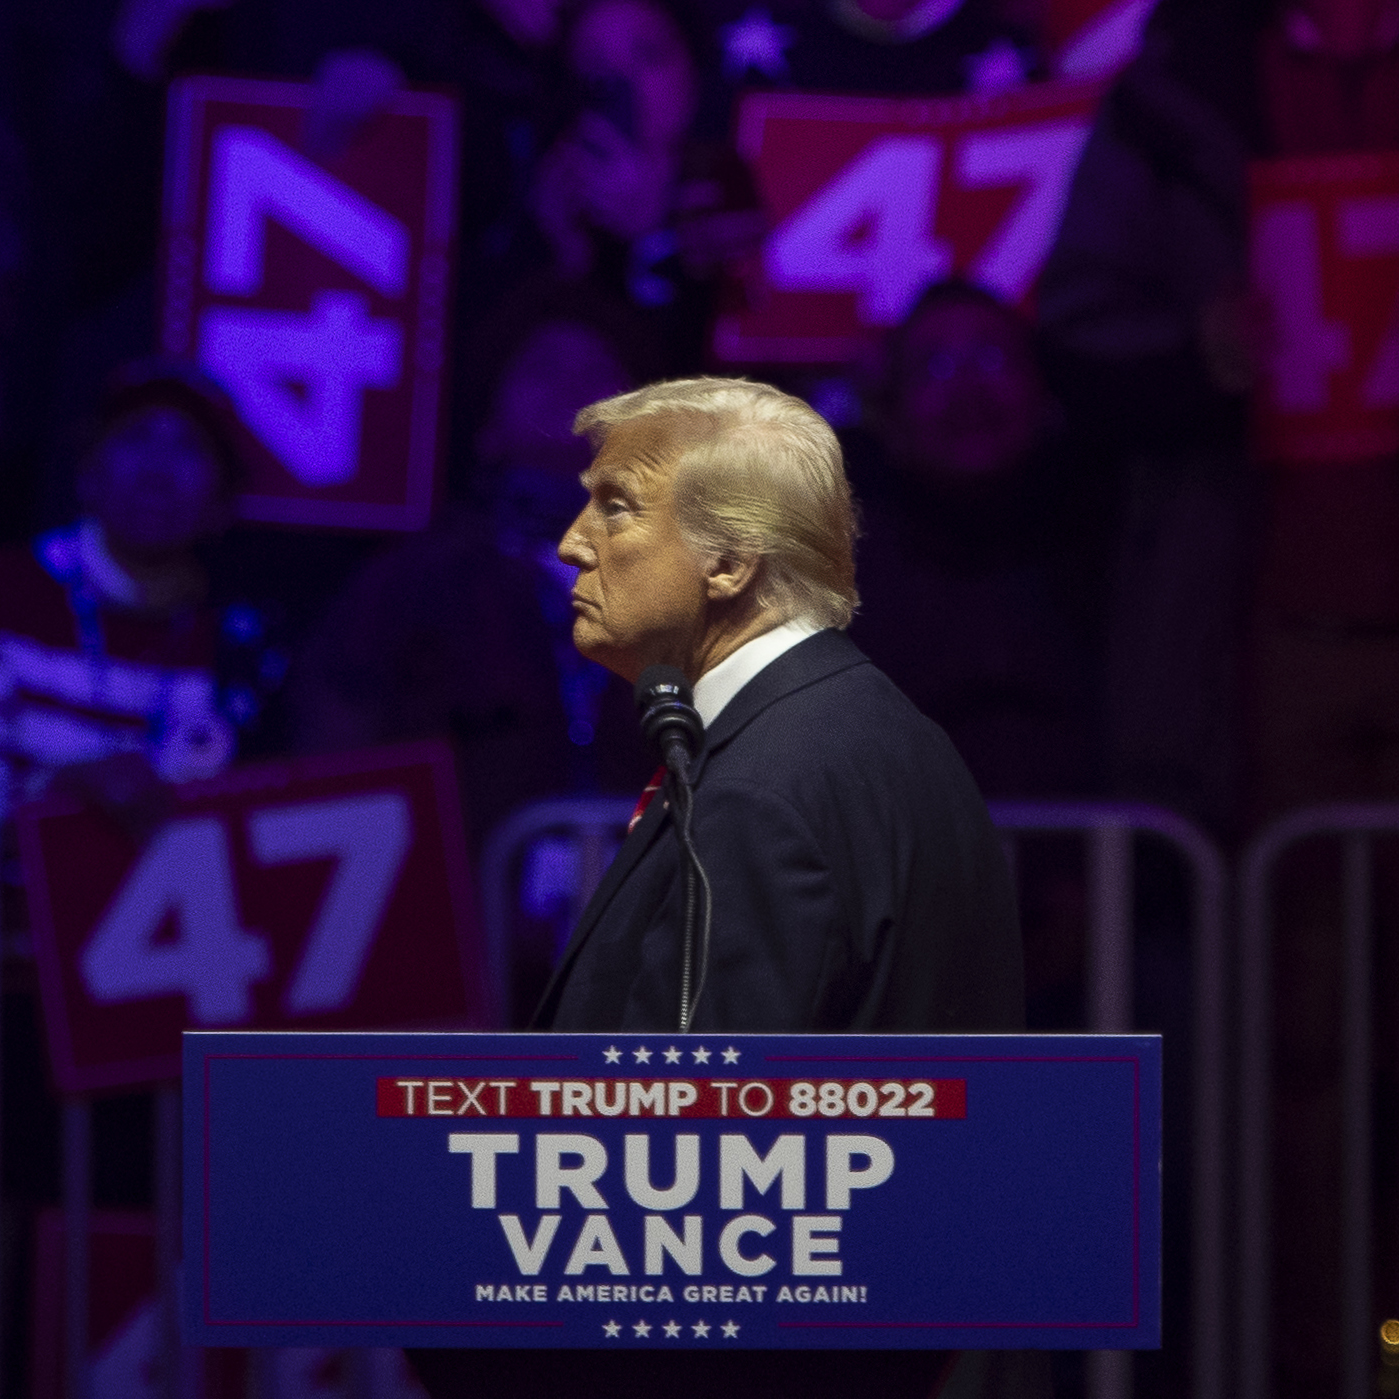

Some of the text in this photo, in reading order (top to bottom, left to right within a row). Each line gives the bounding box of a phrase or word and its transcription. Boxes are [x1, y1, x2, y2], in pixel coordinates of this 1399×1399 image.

[769, 125, 1095, 320] 47
[202, 126, 408, 485] 47
[80, 792, 414, 1024] 47
[395, 1080, 935, 1117] TEXT TRUMP TO 88022
[448, 1133, 895, 1211] TRUMP
[497, 1214, 843, 1277] VANCE
[474, 1284, 868, 1304] MAKE AMERICA GREAT AGAIN!
